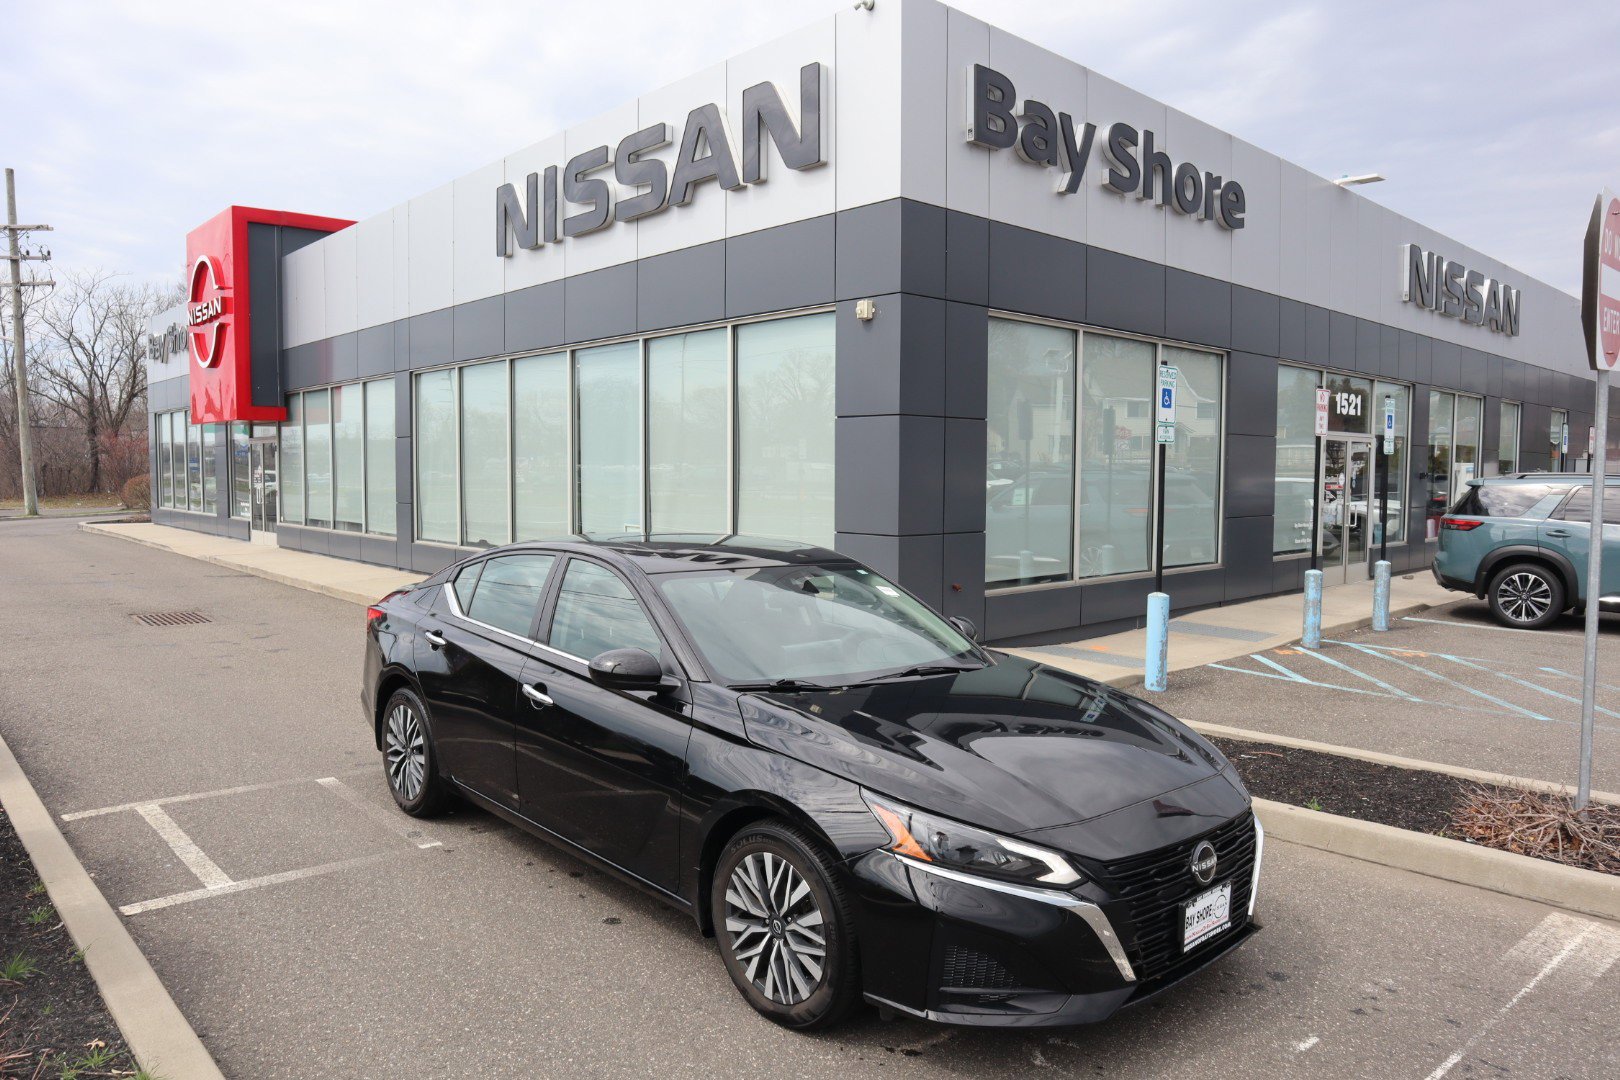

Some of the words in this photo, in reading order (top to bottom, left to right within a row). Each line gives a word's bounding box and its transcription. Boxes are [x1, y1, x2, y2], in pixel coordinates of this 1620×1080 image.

[496, 62, 827, 257] NISSAN
[967, 63, 1096, 194] Bay
[1102, 122, 1246, 230] Shore
[187, 296, 221, 326] NISSAN
[1402, 243, 1521, 337] NISSAN
[1336, 392, 1362, 416] 1521
[1185, 913, 1196, 930] BAY
